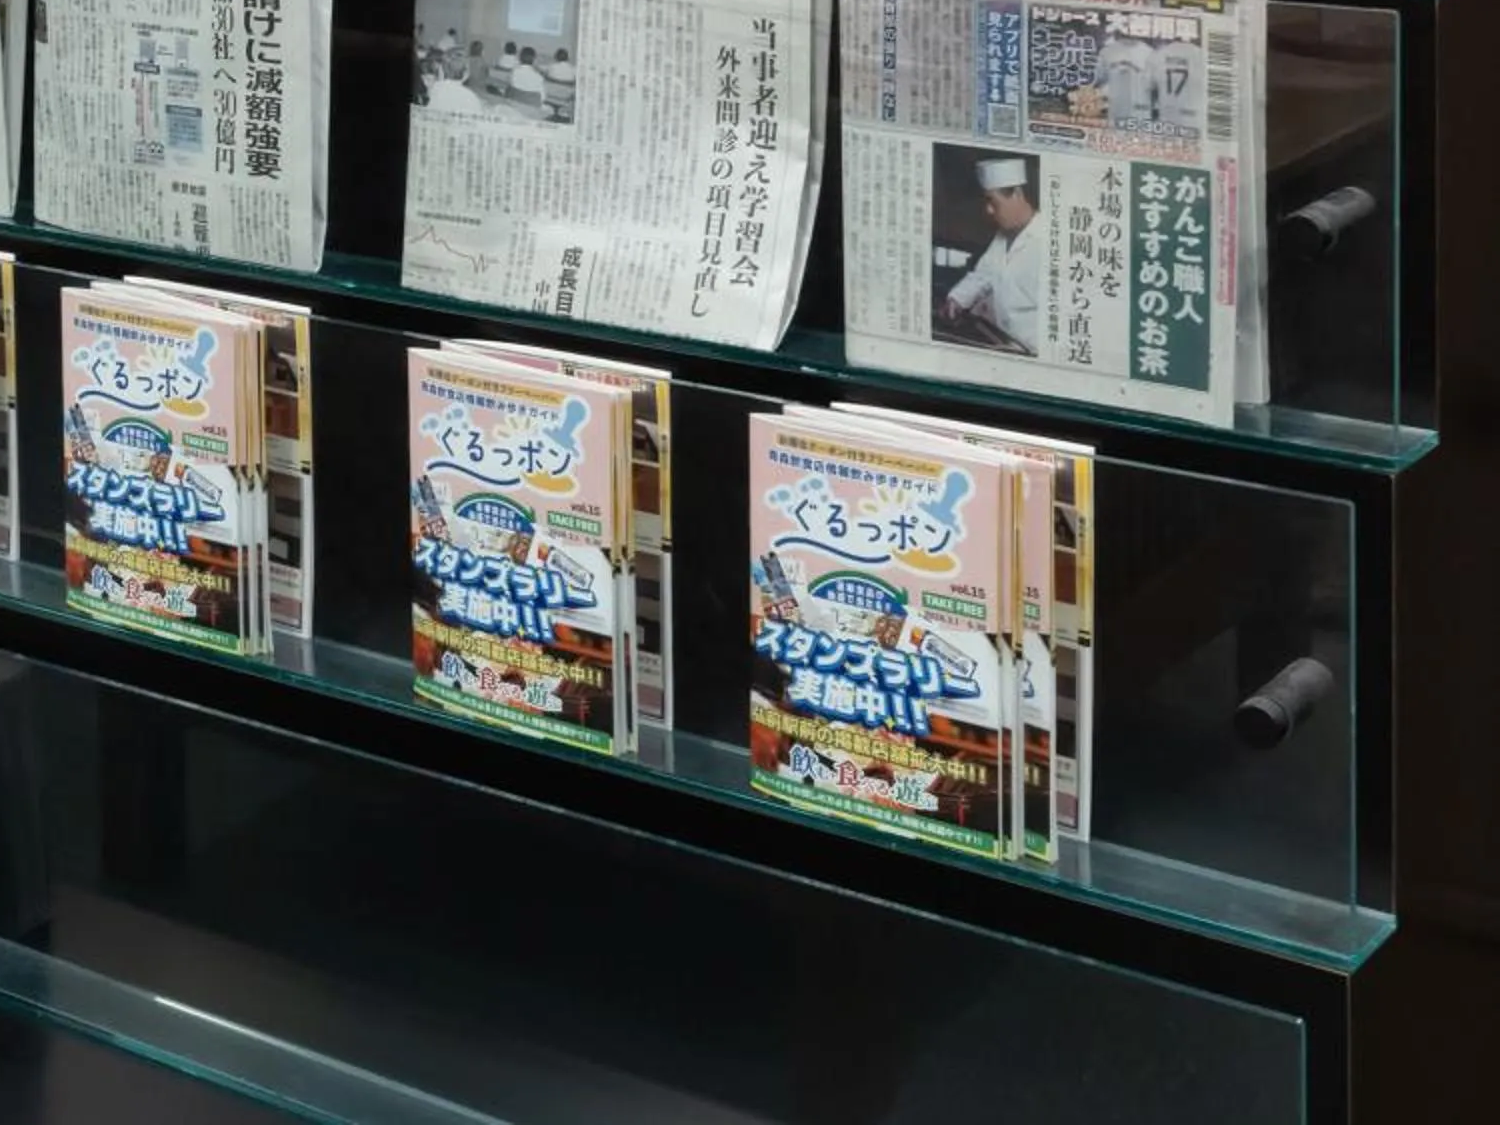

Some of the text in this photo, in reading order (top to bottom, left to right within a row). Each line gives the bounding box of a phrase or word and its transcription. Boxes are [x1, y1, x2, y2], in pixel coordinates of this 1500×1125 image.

[1167, 69, 1189, 94] 17
[690, 46, 742, 317] 外来問診の項目見直し
[729, 18, 779, 288] 当事者迎え学習会
[1098, 166, 1123, 298] 本場の味を
[1174, 176, 1206, 325] がんこ職人
[555, 245, 584, 318] 成長目
[1068, 205, 1093, 365] 静岡から直送
[1138, 170, 1169, 376] おすすめのお茶
[91, 357, 206, 399] ぐるっポン
[440, 426, 571, 476] ぐるっポン
[68, 465, 225, 521] スタンプラリー
[794, 498, 951, 552] ぐるっポン
[415, 538, 598, 608] スタンプラリー
[925, 594, 986, 618] TAKE FREE
[757, 619, 980, 698] スタンプラリー
[788, 668, 931, 735] 実施中!!
